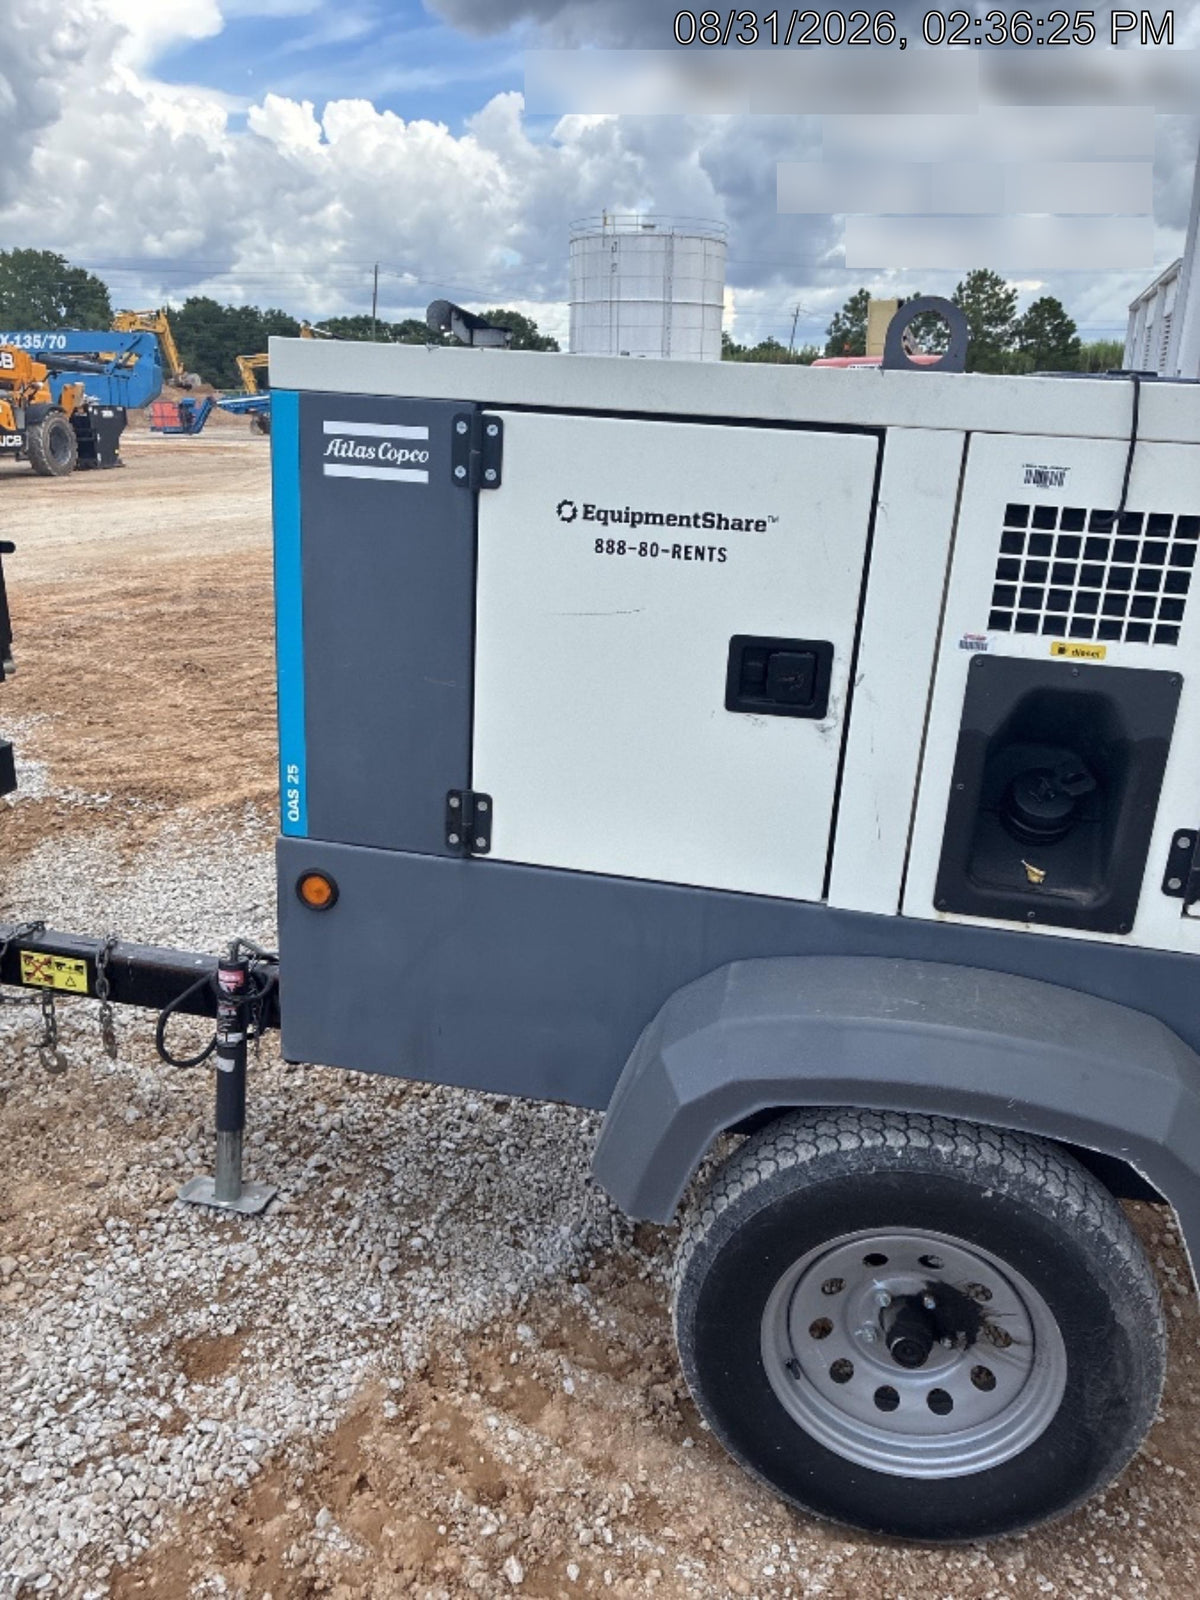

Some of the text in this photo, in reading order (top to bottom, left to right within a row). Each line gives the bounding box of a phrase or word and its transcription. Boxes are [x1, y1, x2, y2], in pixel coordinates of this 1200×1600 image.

[323, 438, 429, 464] Atlas Copco
[582, 503, 767, 532] EquipmentShare
[594, 538, 728, 563] 888-80-RENTS
[287, 764, 300, 822] QAS 25
